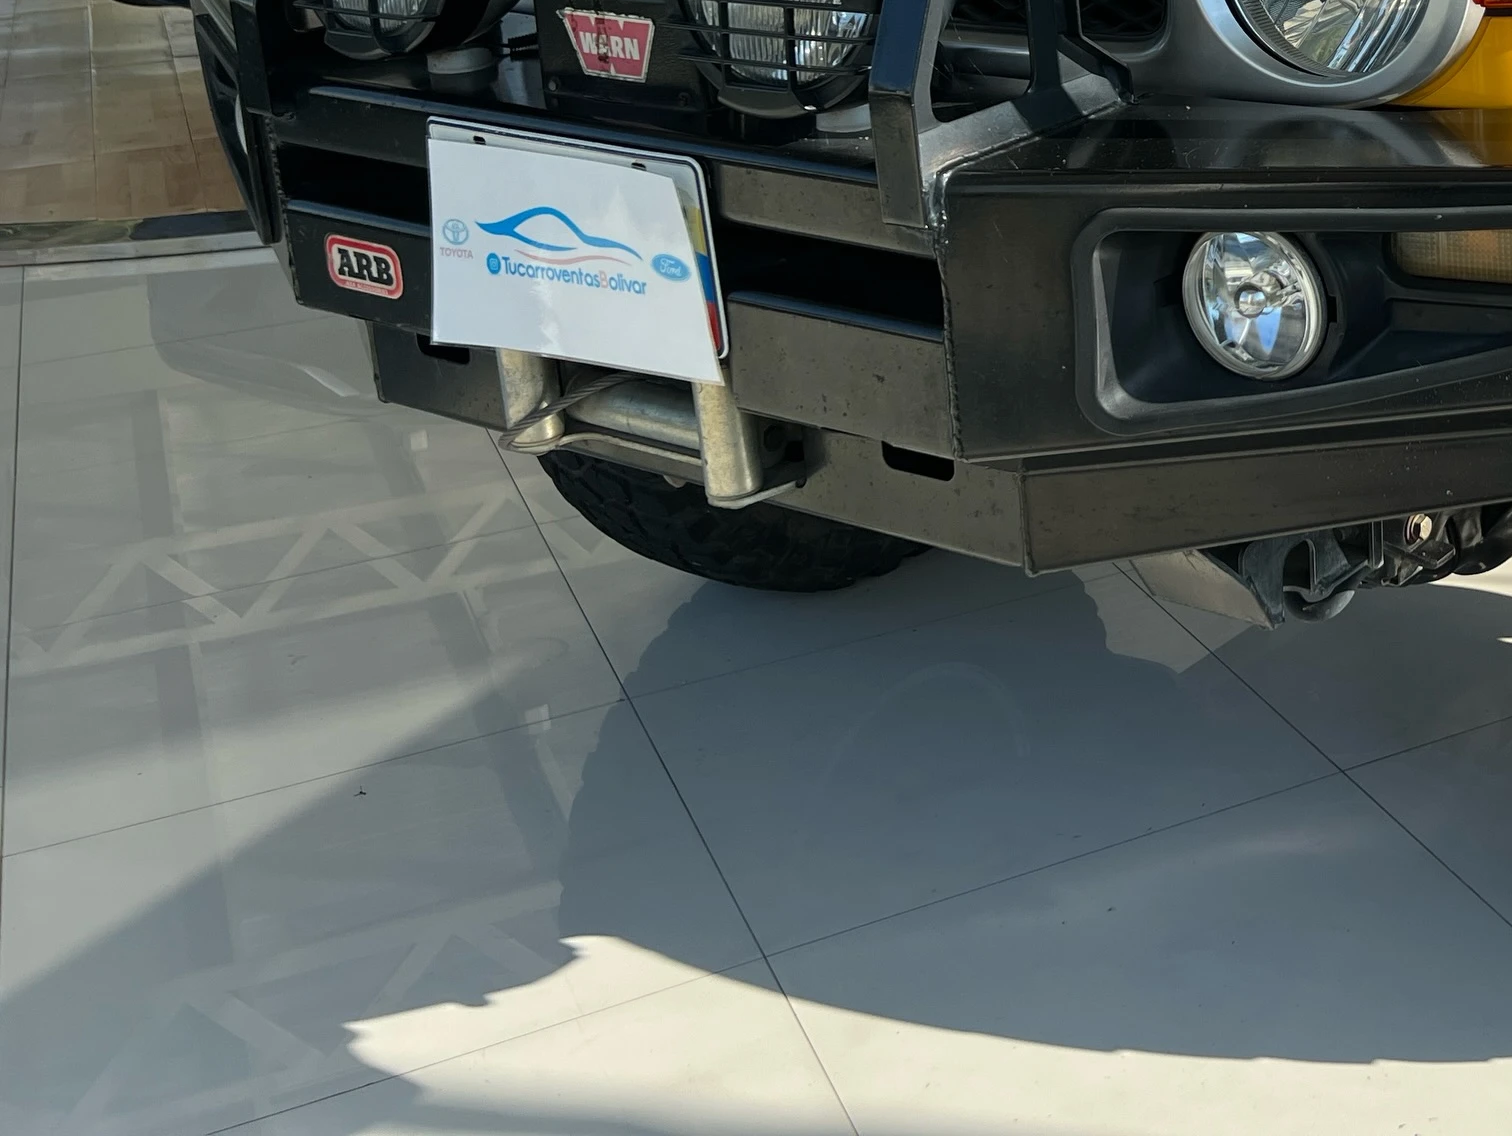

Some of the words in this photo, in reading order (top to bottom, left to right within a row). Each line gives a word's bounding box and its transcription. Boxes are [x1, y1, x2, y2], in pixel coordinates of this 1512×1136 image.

[579, 31, 640, 60] WARN
[337, 247, 394, 286] ARB
[440, 246, 474, 259] TOYOTA
